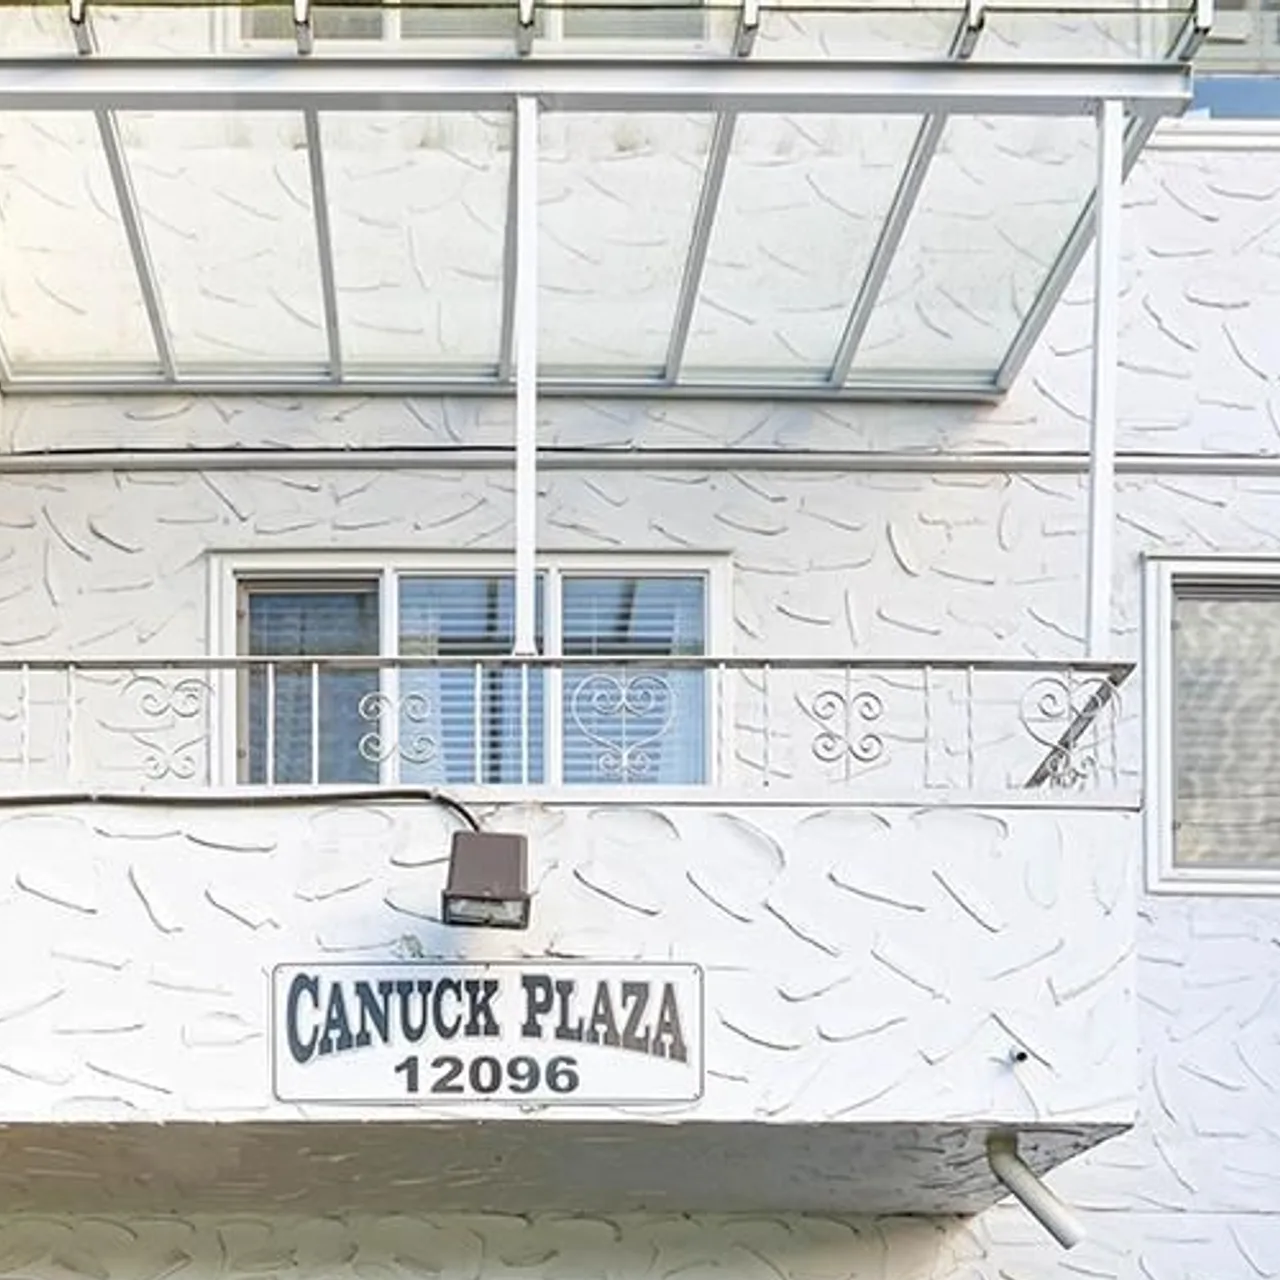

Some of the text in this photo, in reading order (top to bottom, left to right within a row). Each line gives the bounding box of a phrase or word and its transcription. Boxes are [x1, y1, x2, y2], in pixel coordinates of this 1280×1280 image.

[286, 972, 689, 1064] CANUCK PLAZA
[394, 1055, 581, 1094] 12096
